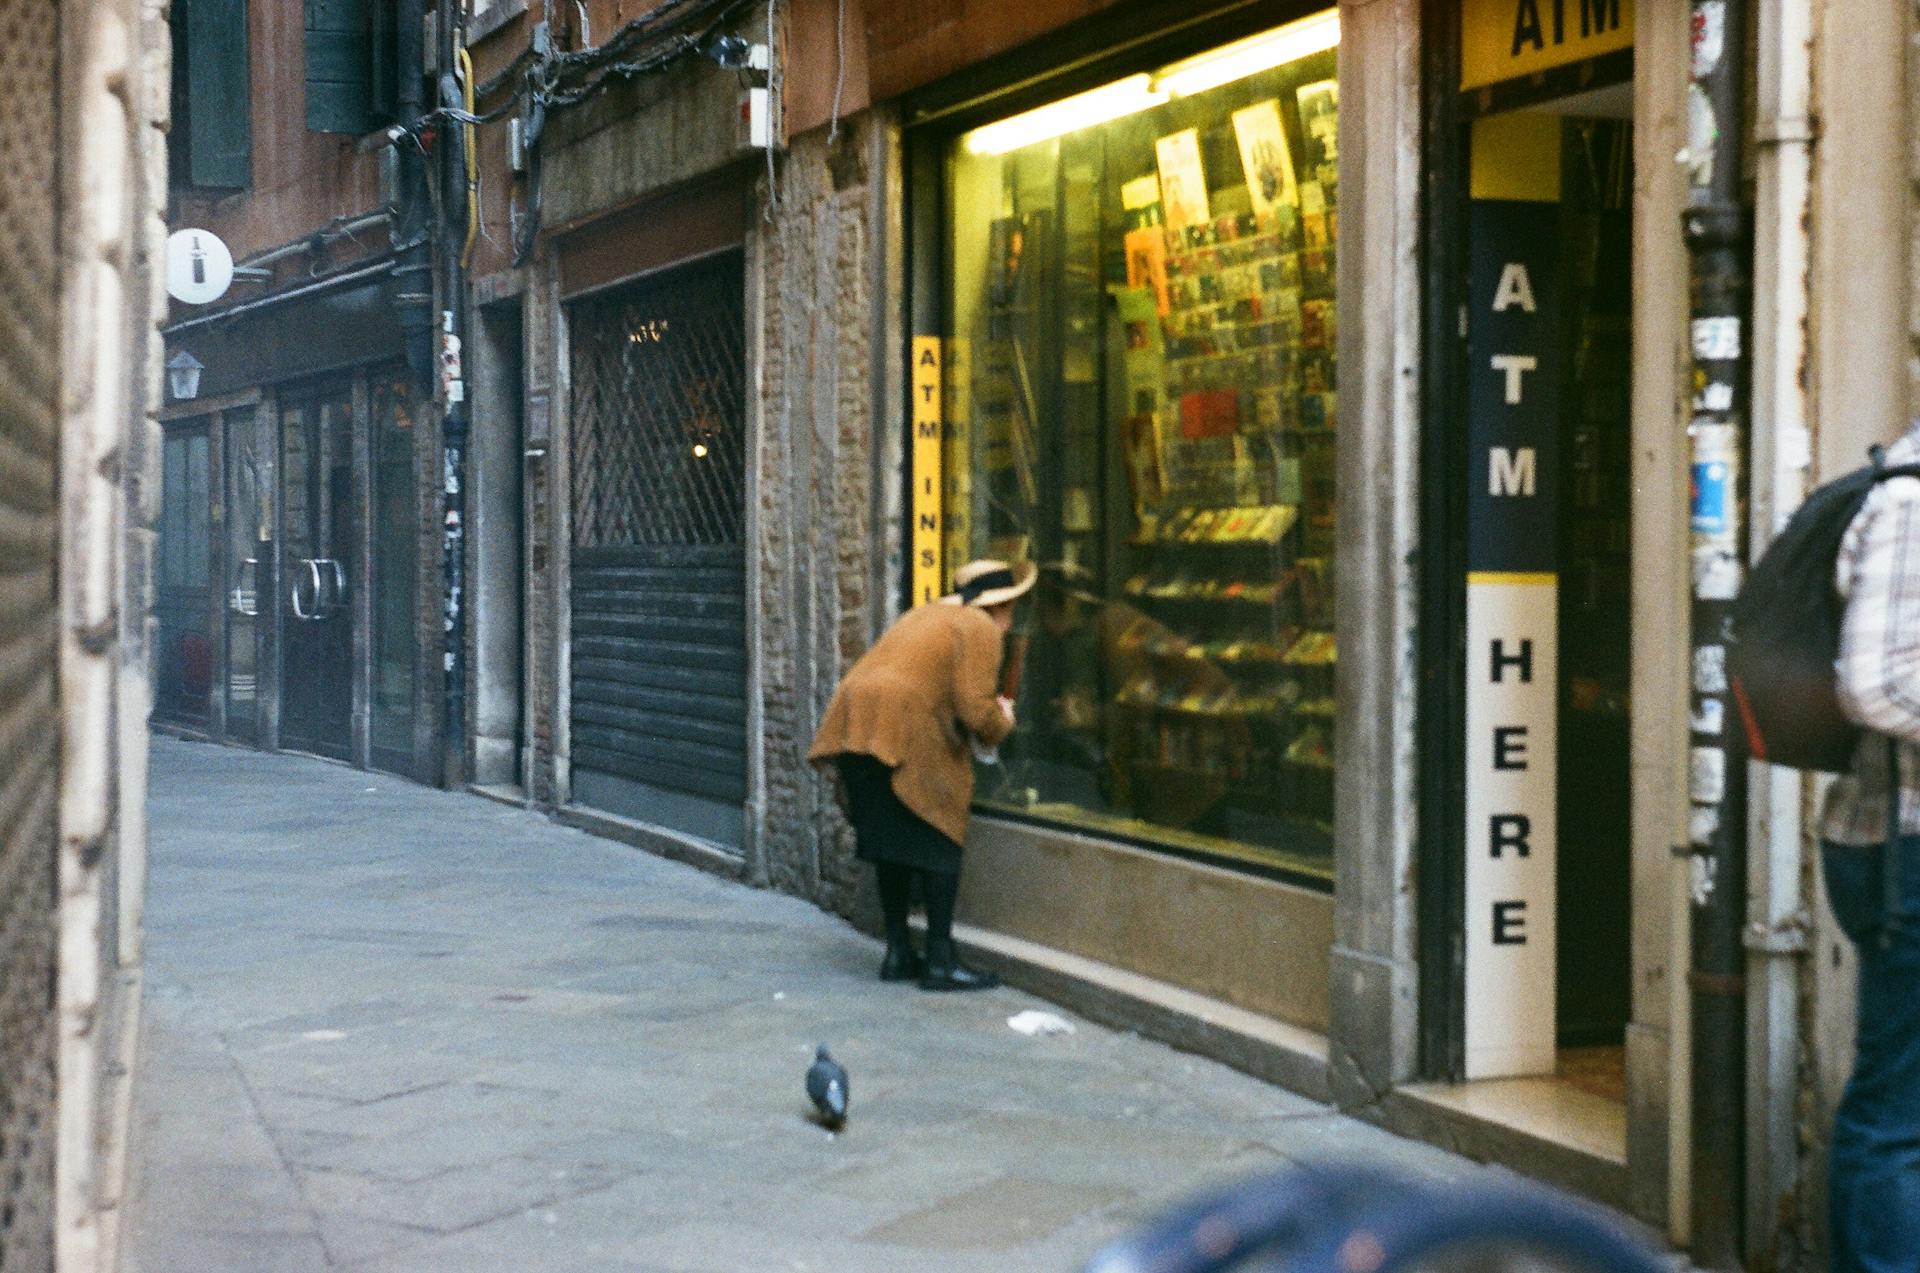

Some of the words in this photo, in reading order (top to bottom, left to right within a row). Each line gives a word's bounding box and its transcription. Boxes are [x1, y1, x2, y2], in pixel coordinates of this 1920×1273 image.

[919, 349, 937, 439] ATM
[1487, 262, 1538, 498] ATM
[1489, 637, 1535, 947] HERE
